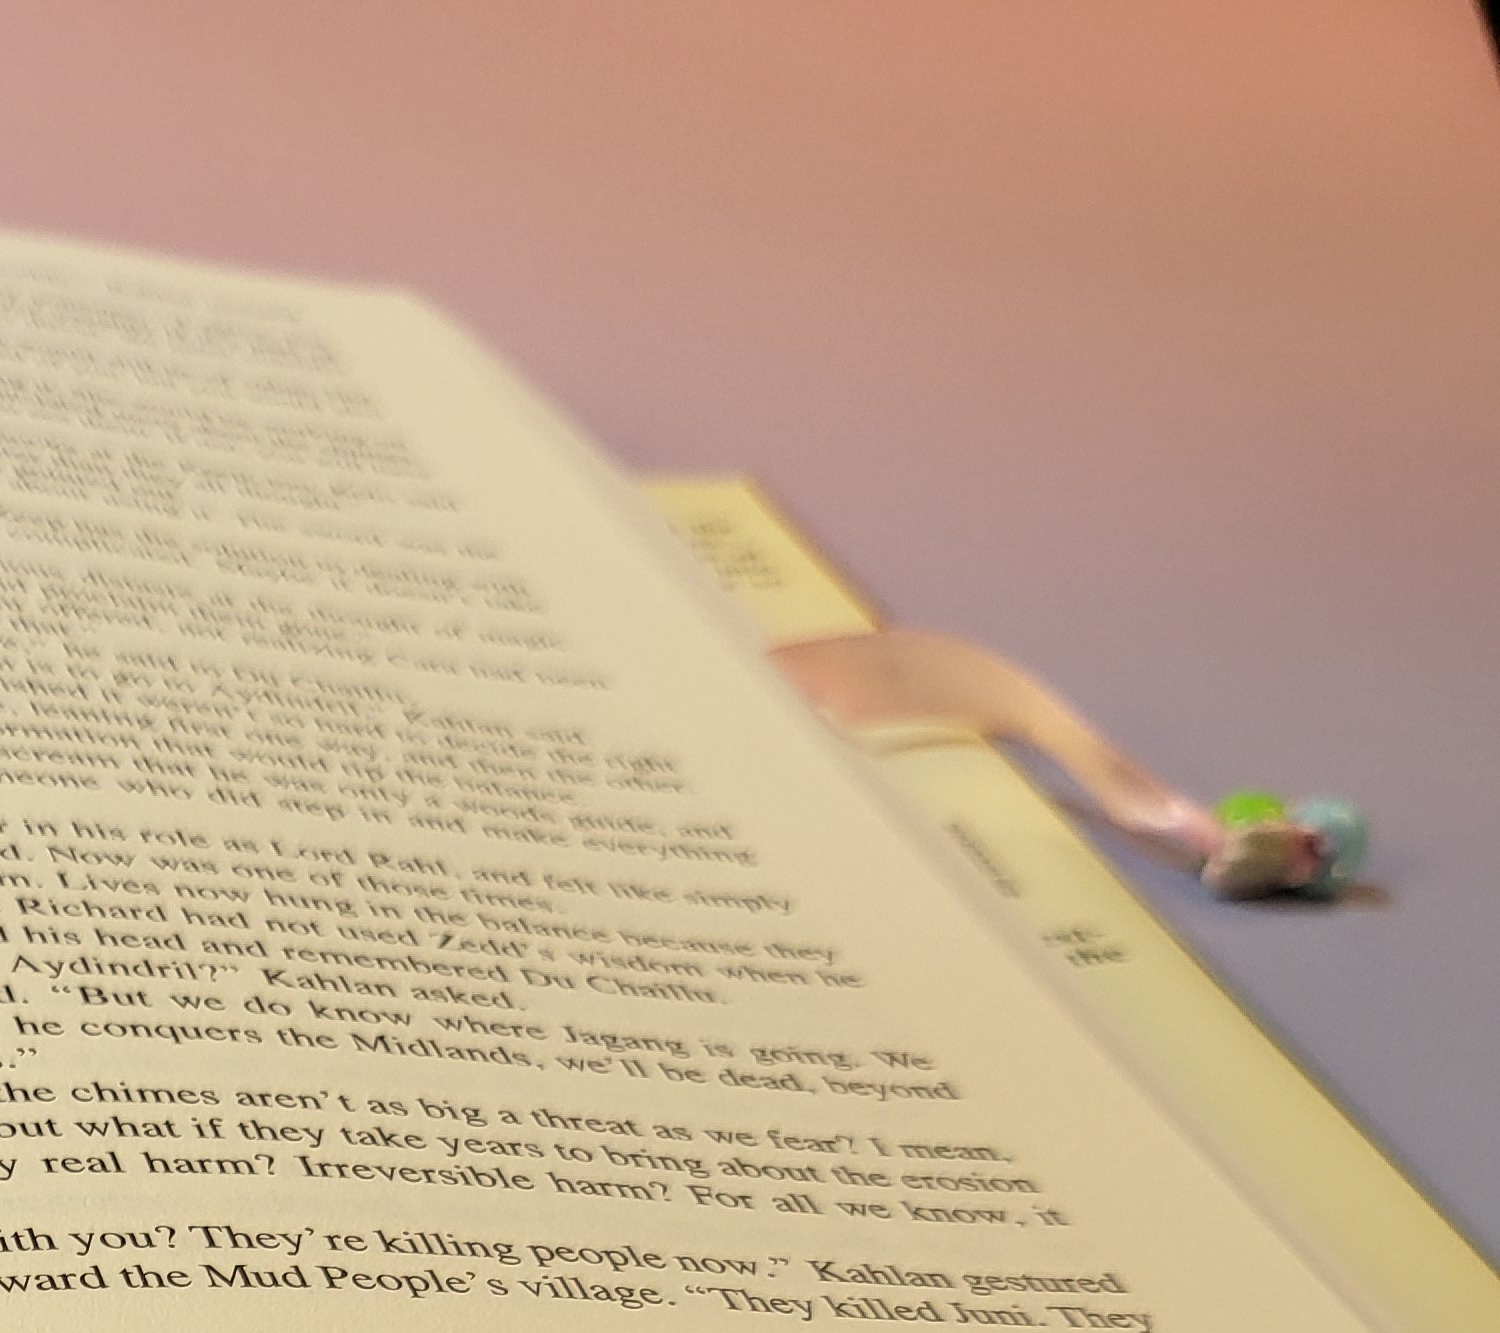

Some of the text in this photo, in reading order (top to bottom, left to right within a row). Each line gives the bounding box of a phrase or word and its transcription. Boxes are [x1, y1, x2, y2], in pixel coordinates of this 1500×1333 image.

[21, 924, 82, 946] his
[93, 926, 187, 952] head
[260, 967, 398, 998] Kahlan
[169, 993, 223, 1010] we
[242, 994, 293, 1016] do
[306, 998, 412, 1027] know
[13, 1015, 61, 1036] he
[80, 1022, 263, 1044] conquers
[276, 1027, 338, 1049] the
[350, 1032, 544, 1070] Midlands,
[71, 1081, 220, 1105] chimes
[235, 1090, 354, 1112] aren’t
[367, 1099, 409, 1116] as
[417, 1097, 488, 1127] big
[498, 1110, 521, 1125] a
[75, 1115, 178, 1138] what
[191, 1117, 222, 1139] if
[237, 1119, 324, 1148] they
[340, 1126, 427, 1149] take
[437, 1136, 545, 1158] years
[42, 1150, 124, 1173] real
[142, 1151, 275, 1176] harm?
[298, 1155, 535, 1190] Irreversible
[545, 1170, 672, 1203] harm?
[69, 1225, 176, 1257] you?
[188, 1224, 368, 1256] They’re
[374, 1229, 522, 1266] killing
[526, 1243, 668, 1273] people
[673, 1254, 790, 1279] now.”
[119, 1264, 192, 1289] the
[202, 1264, 311, 1289] Mud
[318, 1265, 509, 1299] People’s
[517, 1274, 677, 1311] village.
